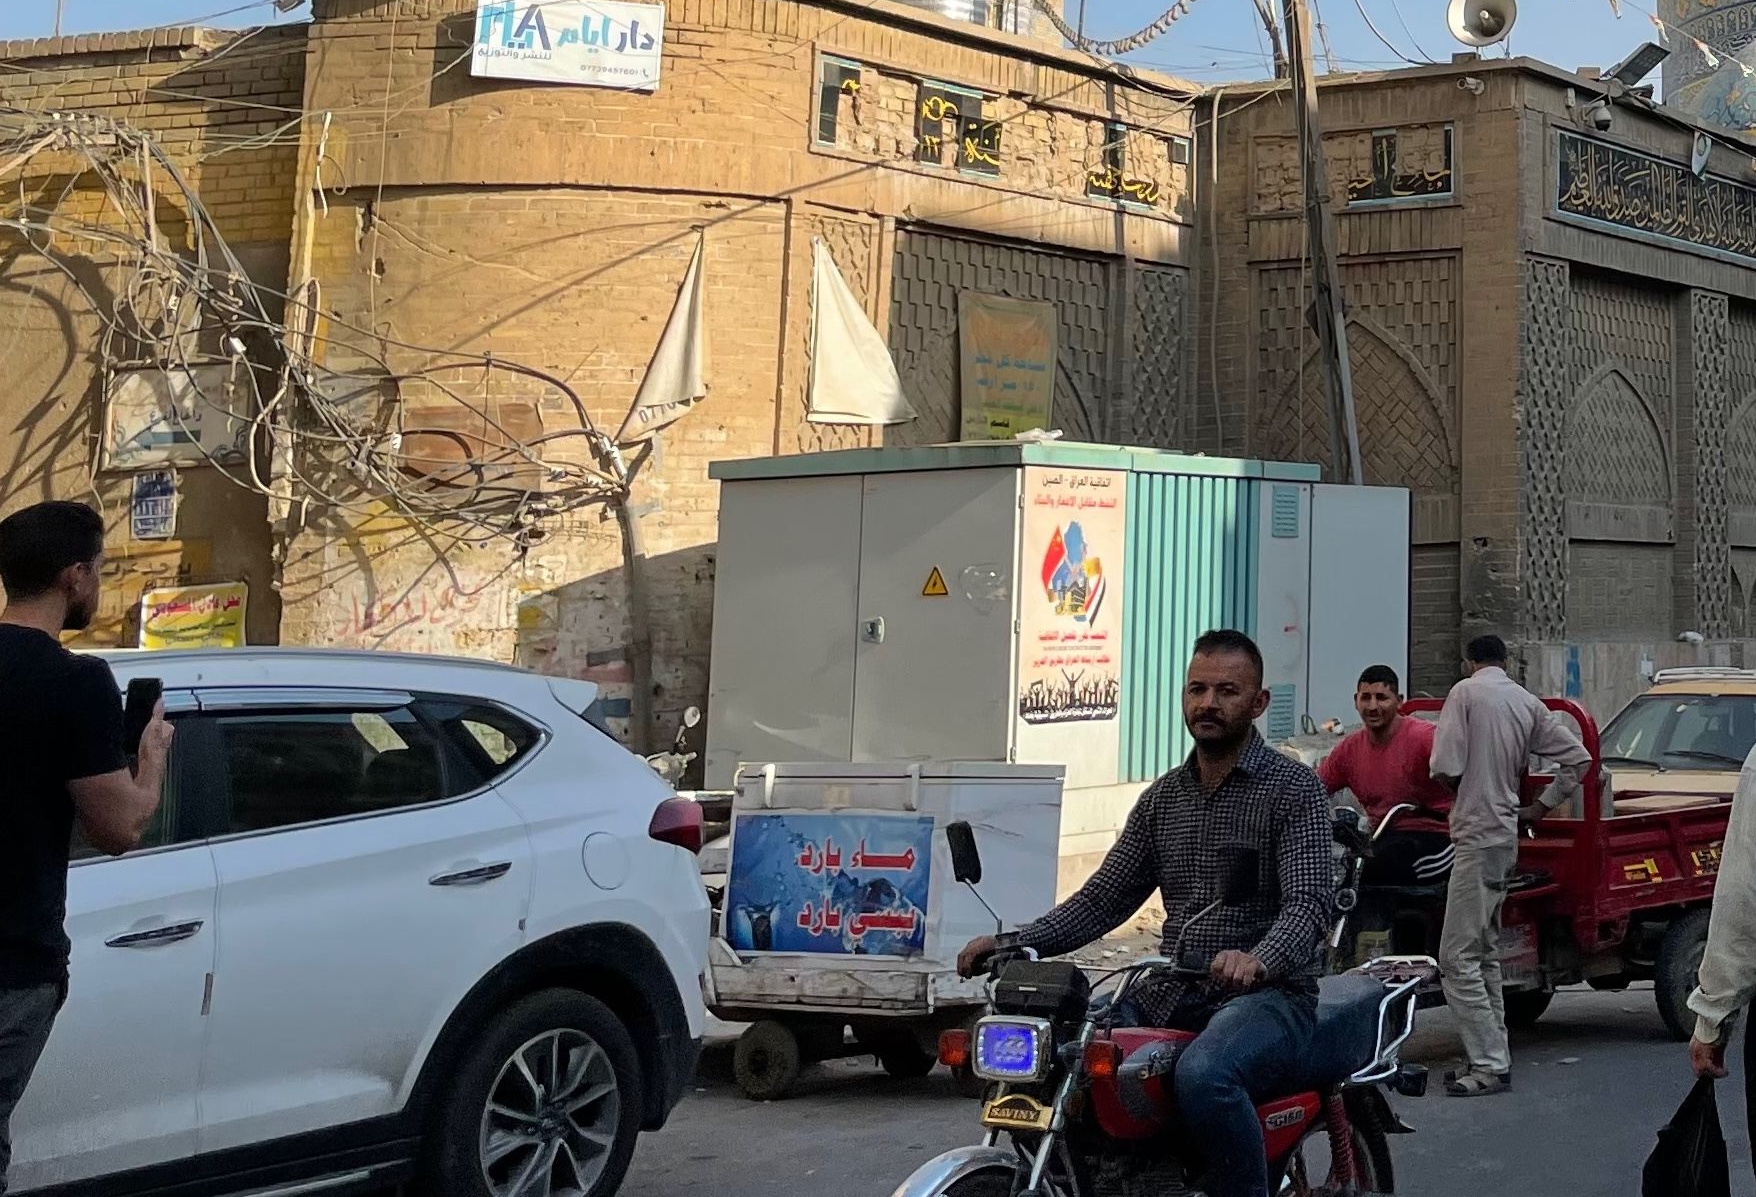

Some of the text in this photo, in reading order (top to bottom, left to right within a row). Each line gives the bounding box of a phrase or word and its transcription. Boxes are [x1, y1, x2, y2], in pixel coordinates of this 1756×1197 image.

[557, 15, 655, 53] دار ايام
[478, 48, 552, 61] للنشر والتوزيع
[1043, 474, 1063, 488] الصين
[1069, 475, 1088, 489] العراق
[797, 836, 916, 876] ماء بارد
[797, 897, 917, 940] بيبسي بارد
